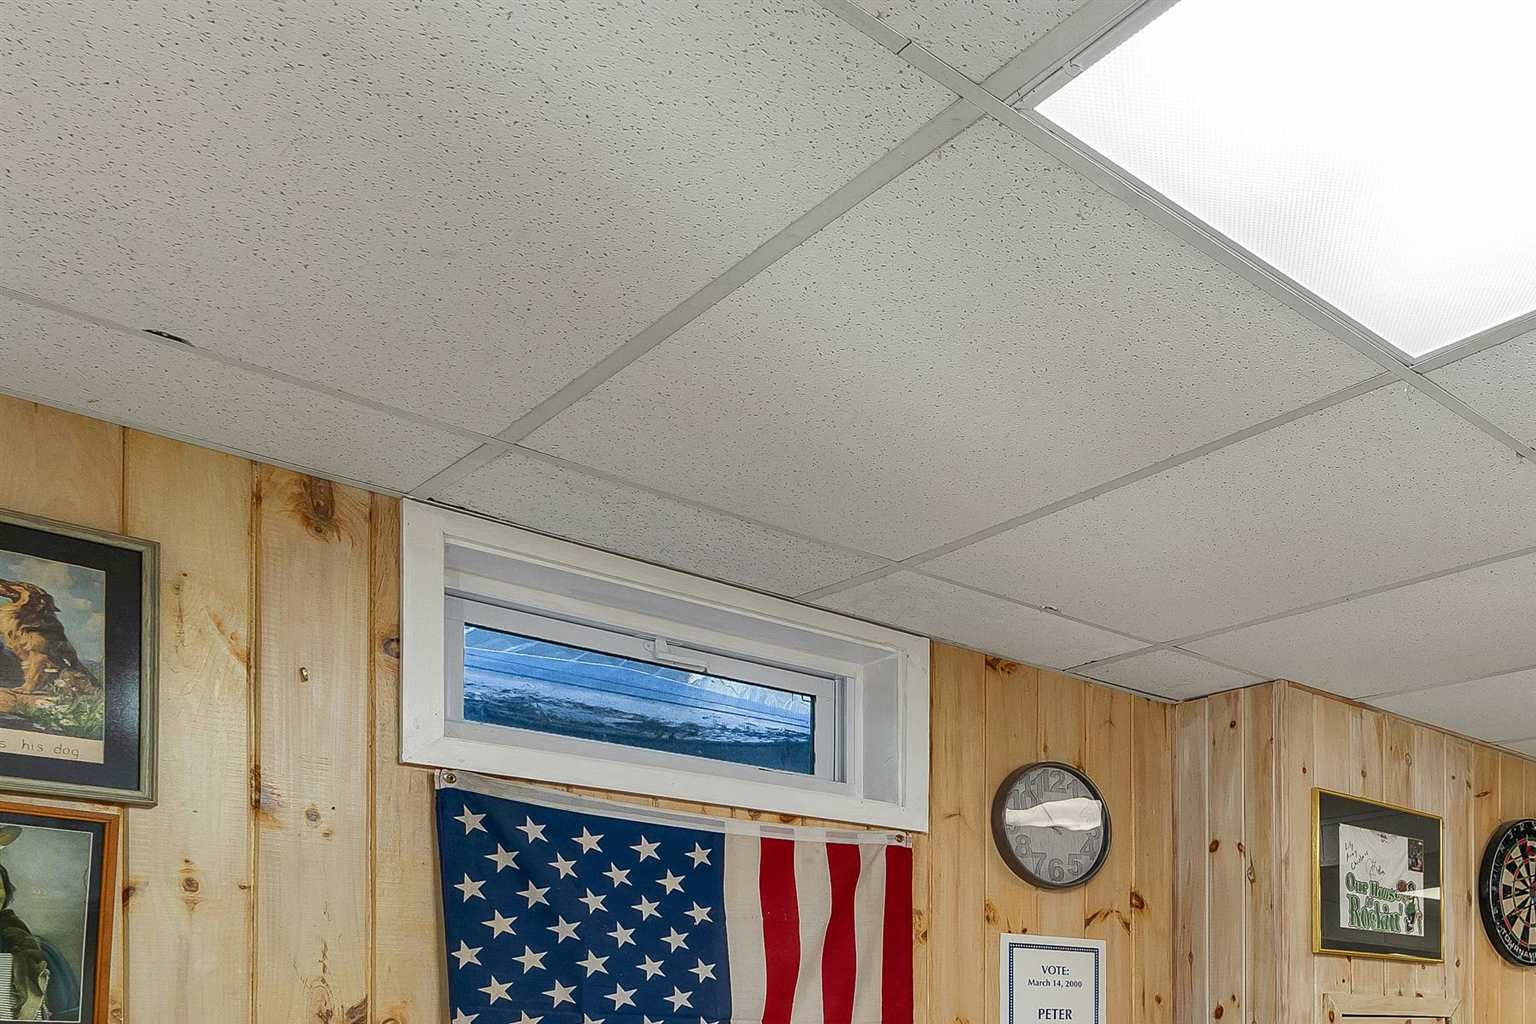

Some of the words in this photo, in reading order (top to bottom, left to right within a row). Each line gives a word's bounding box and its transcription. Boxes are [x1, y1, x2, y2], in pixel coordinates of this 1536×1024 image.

[21, 738, 44, 752] his
[53, 743, 79, 760] dog
[1015, 834, 1032, 858] 8
[1031, 851, 1047, 876] 7
[1048, 857, 1065, 881] 6
[1369, 880, 1402, 903] Hous
[1041, 965, 1070, 976] VOTE:
[1027, 979, 1051, 987] March
[1053, 980, 1064, 988] 14,
[1065, 980, 1082, 988] 2000
[1038, 1008, 1072, 1020] PETER
